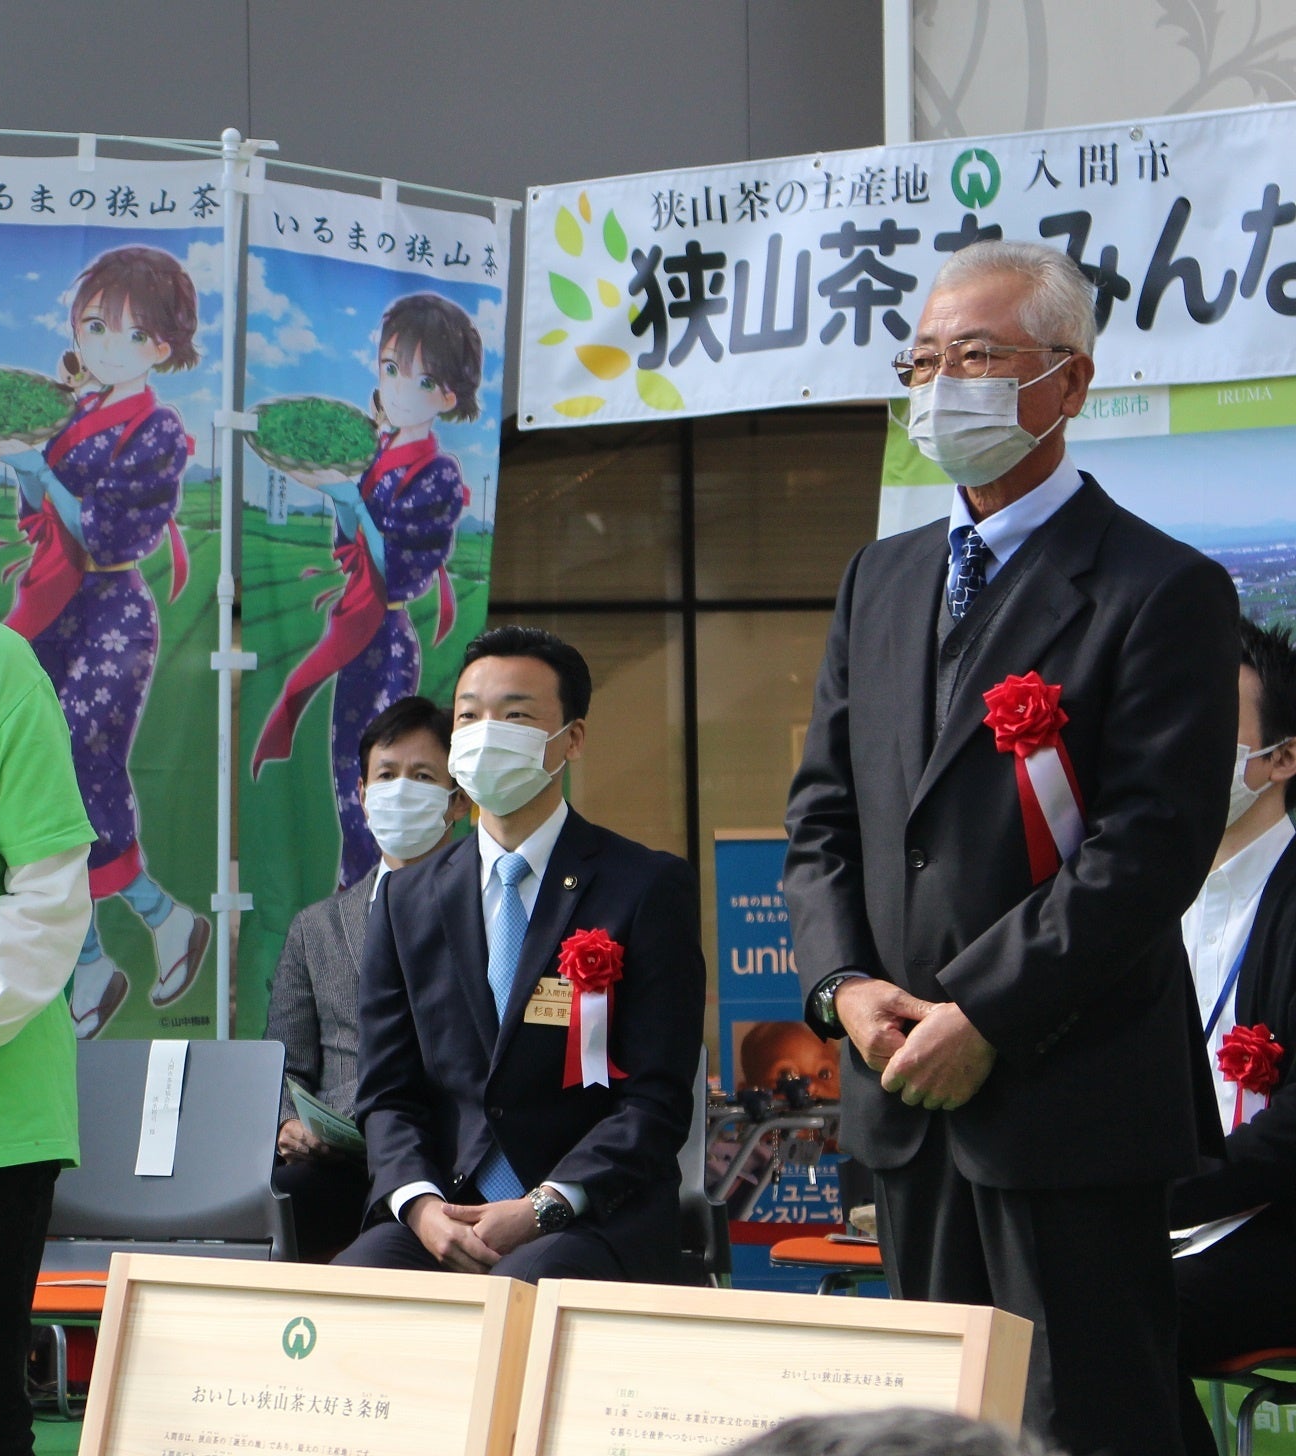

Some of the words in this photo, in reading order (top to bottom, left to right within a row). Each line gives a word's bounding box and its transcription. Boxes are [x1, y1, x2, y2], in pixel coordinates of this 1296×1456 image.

[650, 161, 932, 231] 狭山茶の主産地
[1025, 139, 1171, 193] 入間市
[273, 211, 499, 278] いるまの狭山茶
[1217, 386, 1273, 406] IRUMA
[192, 1385, 391, 1420] おいしい狭山茶大好き条例
